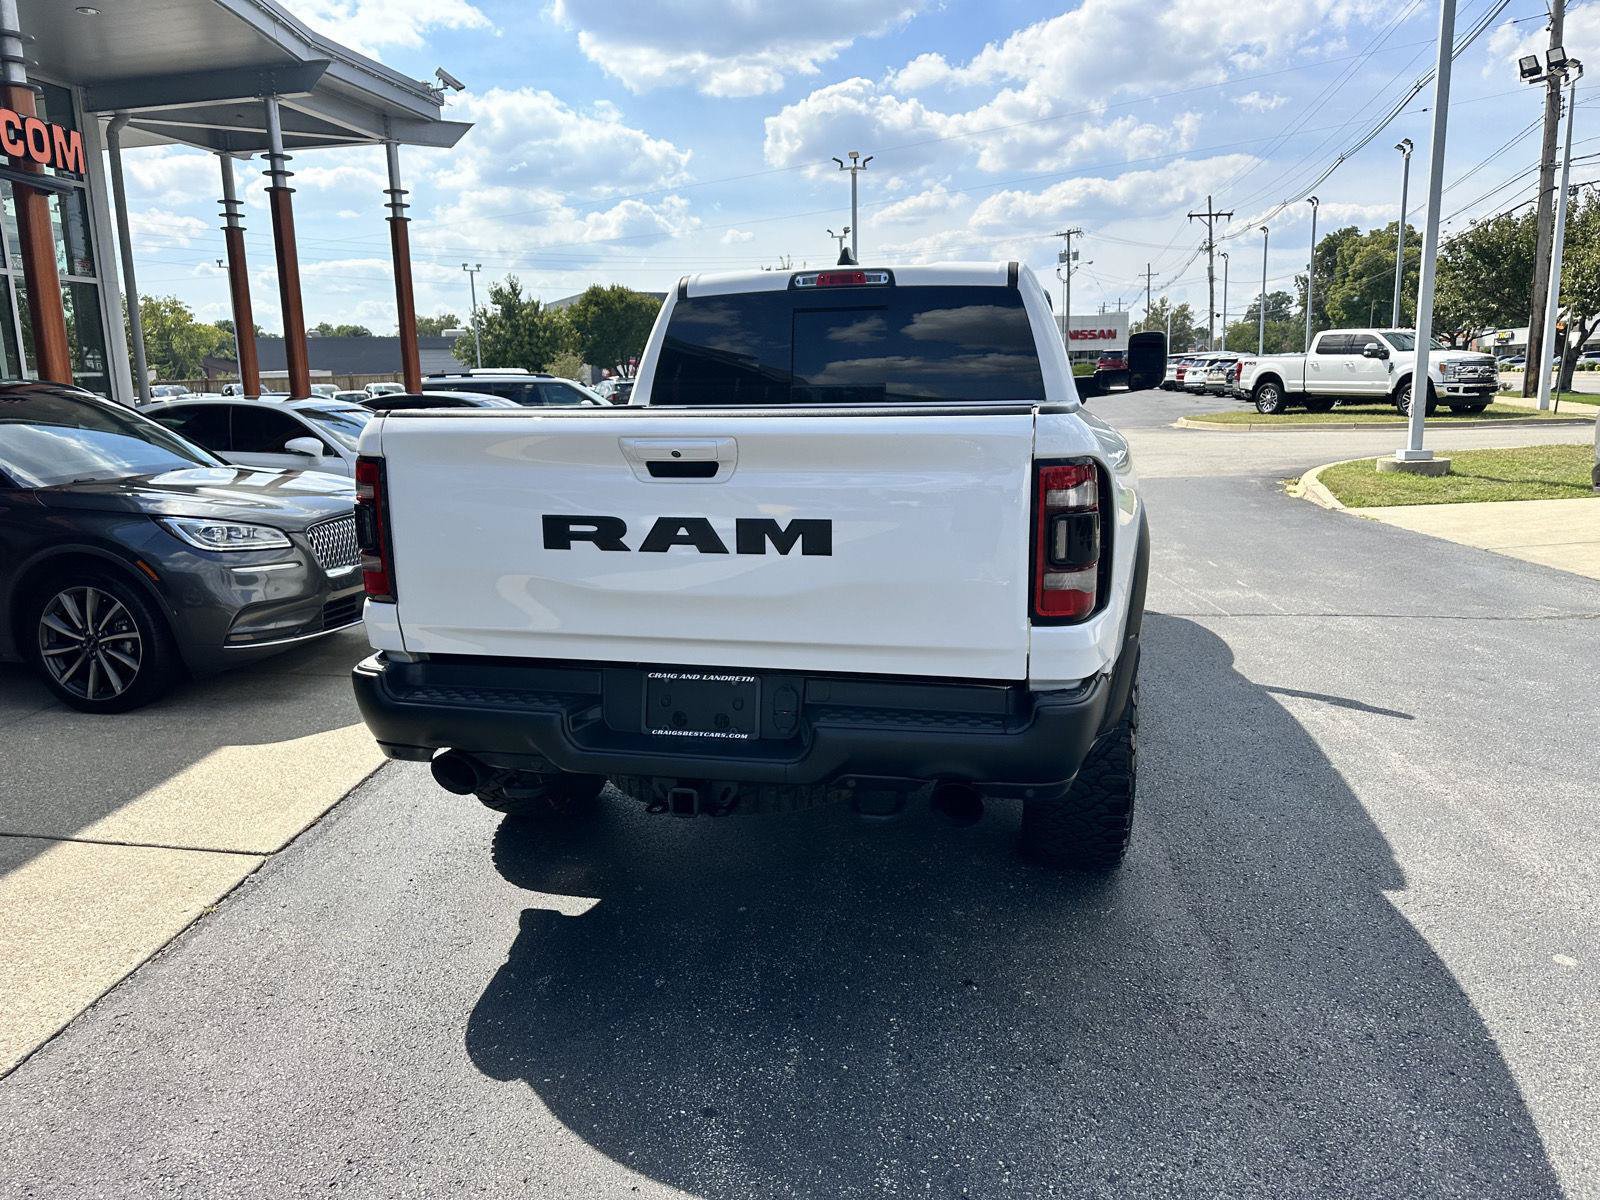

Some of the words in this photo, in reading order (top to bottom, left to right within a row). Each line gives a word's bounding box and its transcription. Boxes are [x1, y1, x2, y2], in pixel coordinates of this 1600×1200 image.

[0, 108, 86, 174] COM
[1068, 328, 1117, 340] NISSAN
[541, 514, 832, 556] RAM
[702, 674, 755, 682] LANDRETH
[651, 729, 749, 739] CRAIGSBESTCARS.COM
